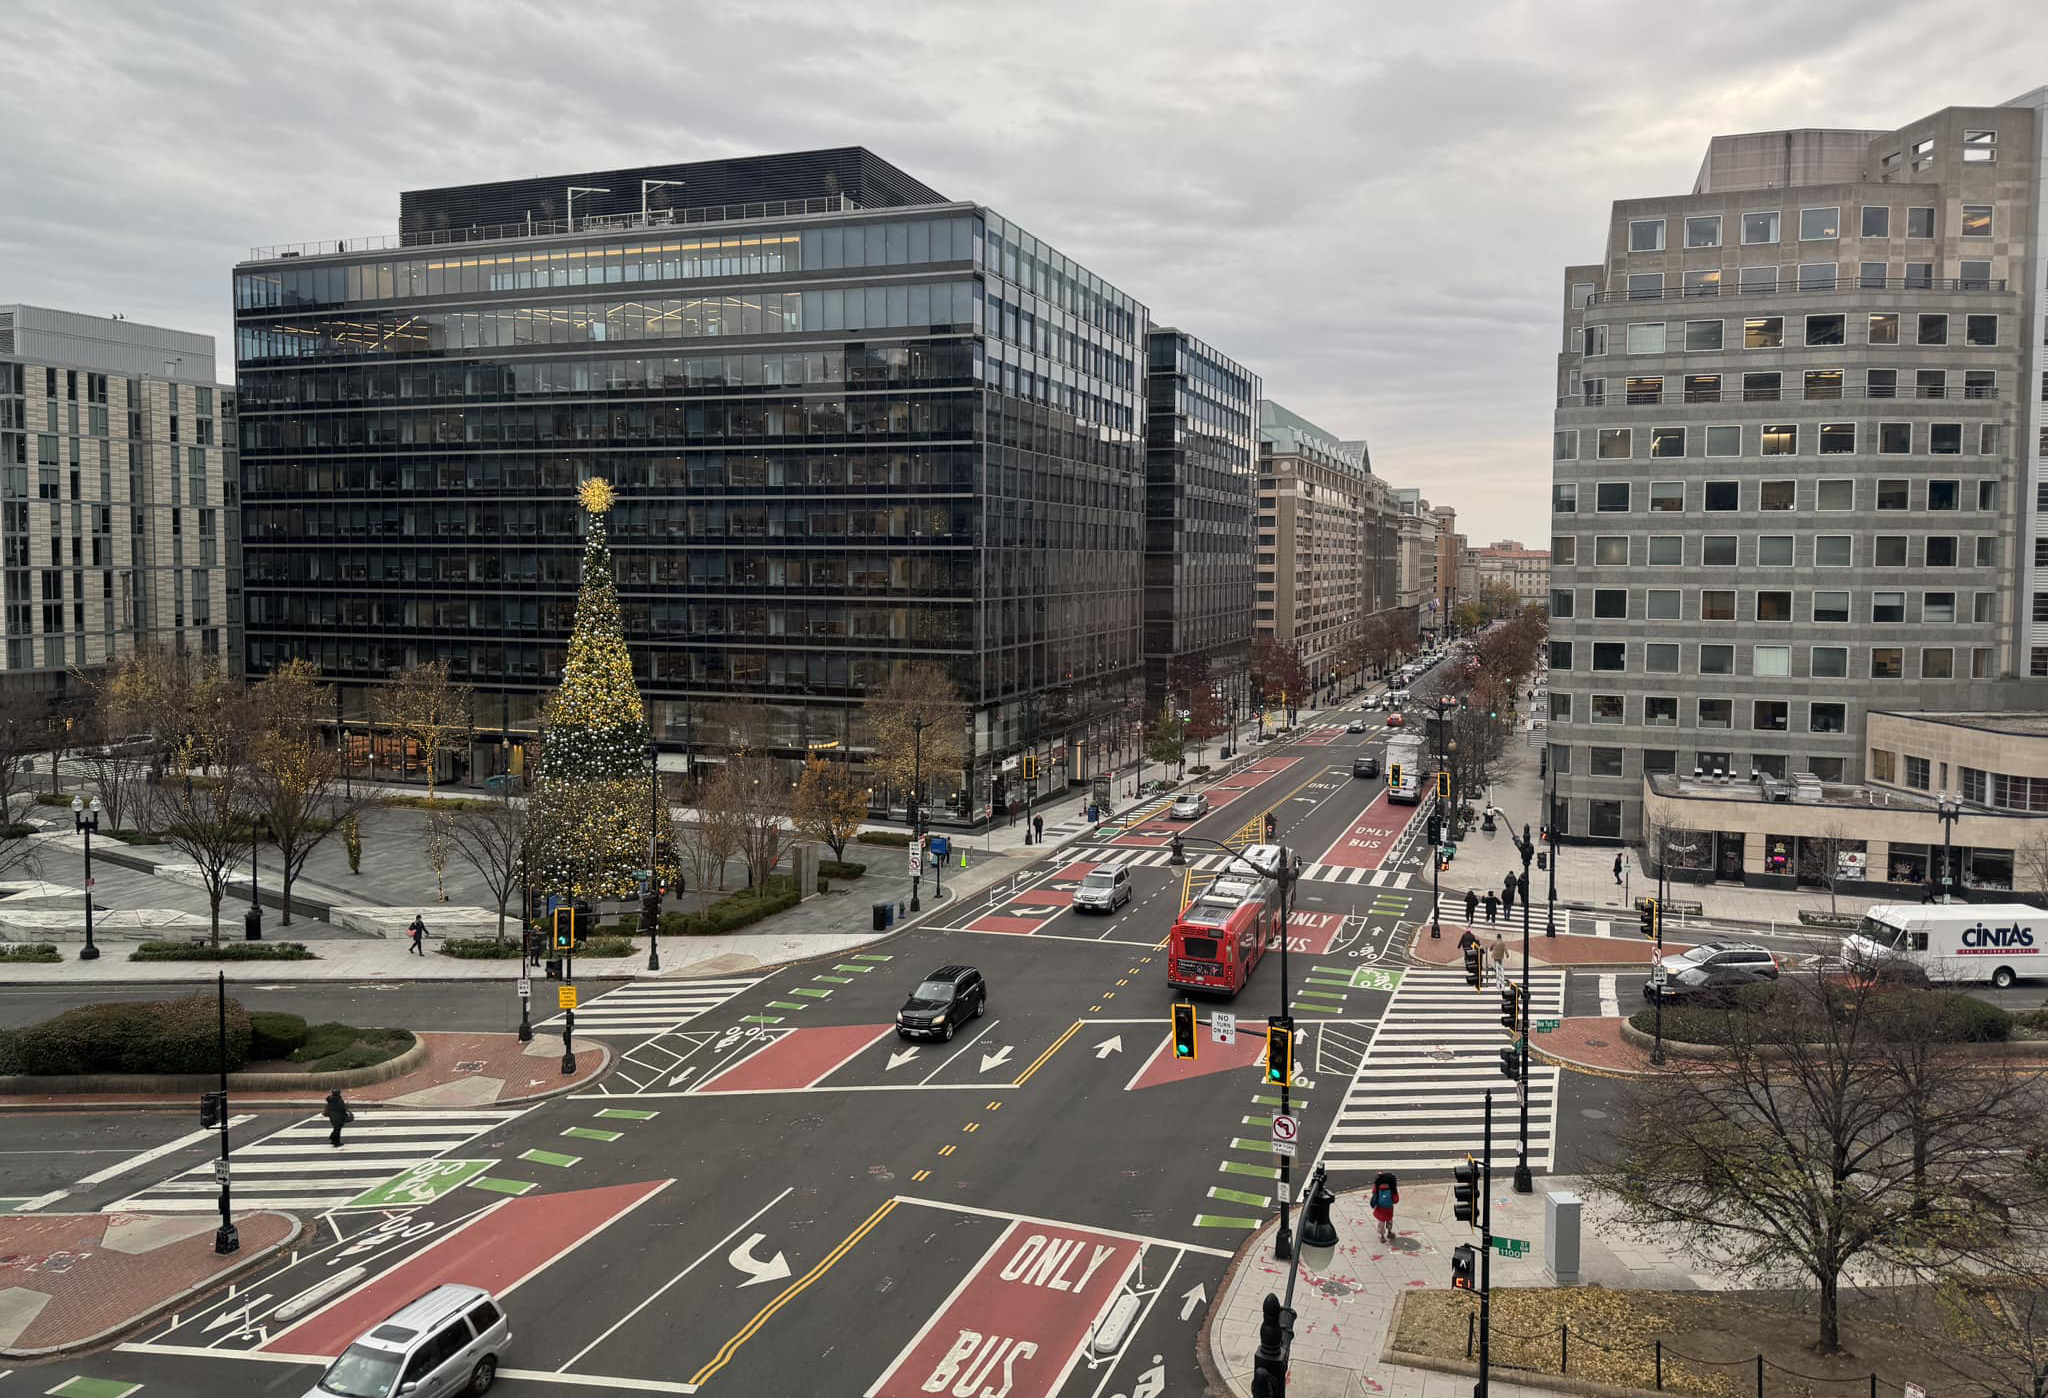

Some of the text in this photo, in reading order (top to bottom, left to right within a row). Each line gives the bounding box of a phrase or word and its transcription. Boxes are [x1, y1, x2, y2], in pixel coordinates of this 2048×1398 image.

[1307, 782, 1339, 790] ONLY
[1355, 826, 1393, 837] ONLY
[1348, 838, 1381, 849] BUS
[1217, 1014, 1229, 1022] NO
[1499, 1249, 1521, 1258] 1100
[1000, 1234, 1116, 1294] ONLY
[920, 1329, 1039, 1398] BUS
